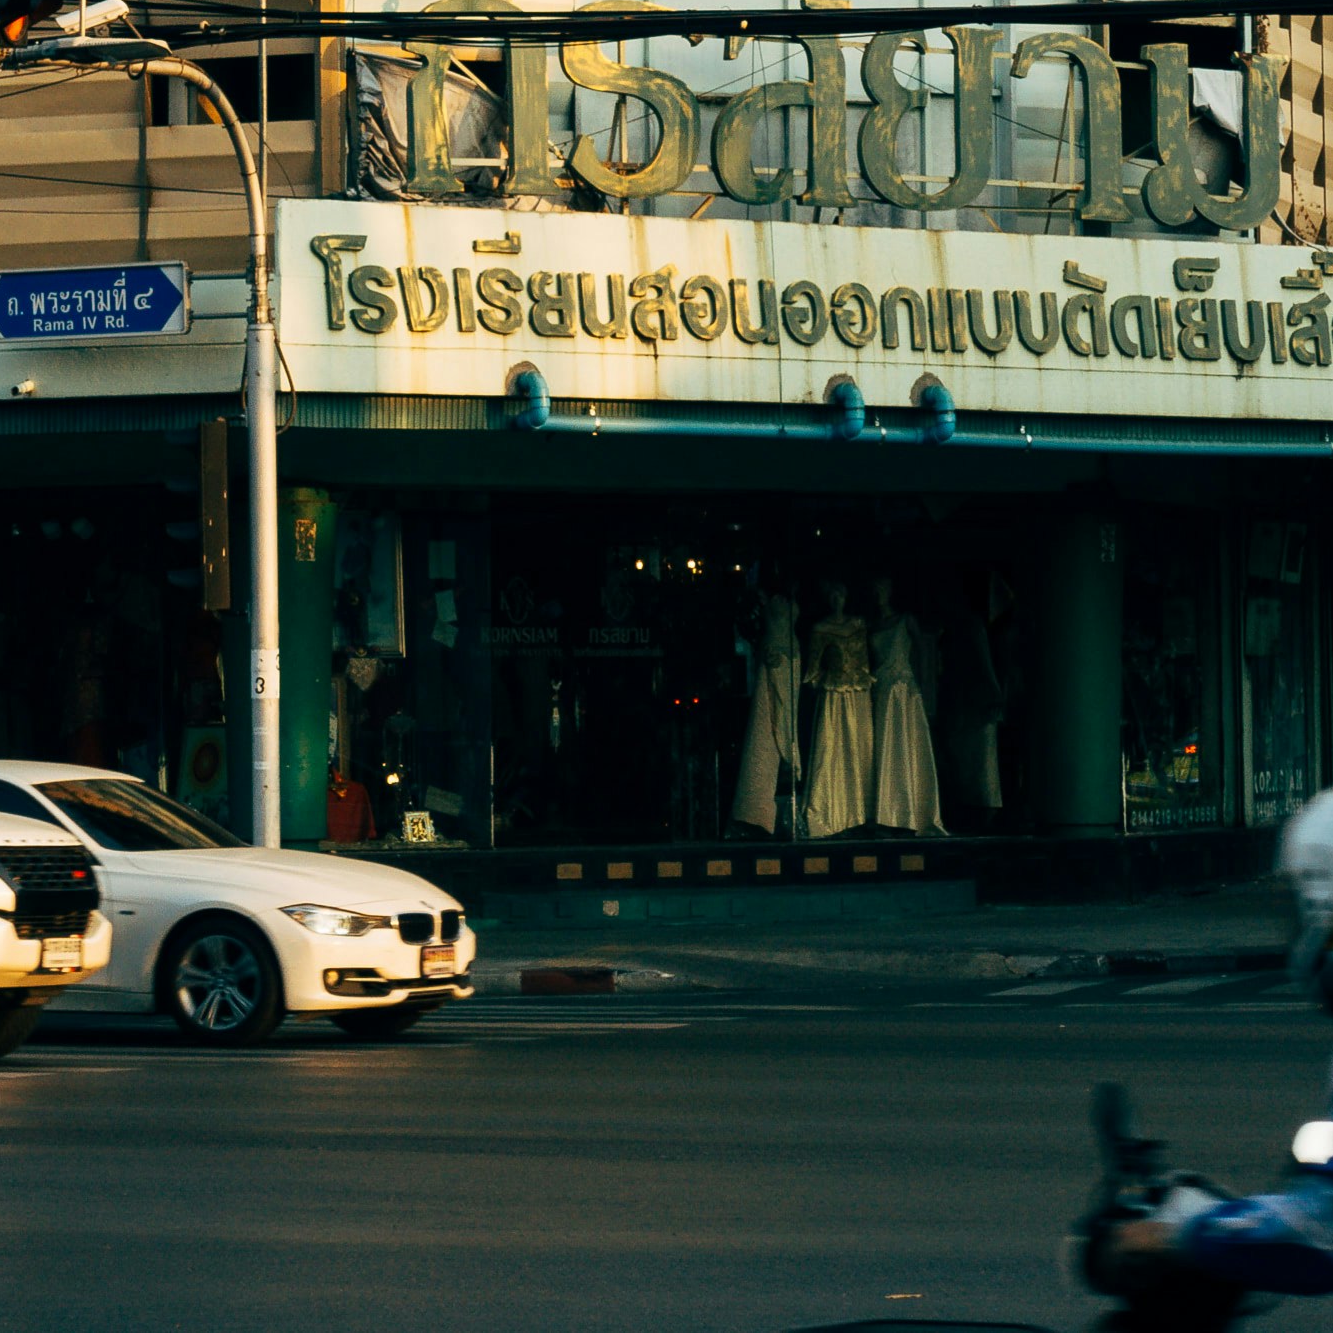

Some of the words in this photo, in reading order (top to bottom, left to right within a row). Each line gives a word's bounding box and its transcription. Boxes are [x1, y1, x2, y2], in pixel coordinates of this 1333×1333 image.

[7, 296, 24, 316] ถ.
[29, 271, 128, 315] พระรามที่
[133, 287, 154, 310] ๔
[33, 318, 75, 332] Rama
[82, 316, 97, 330] IV
[105, 315, 130, 329] Rd.
